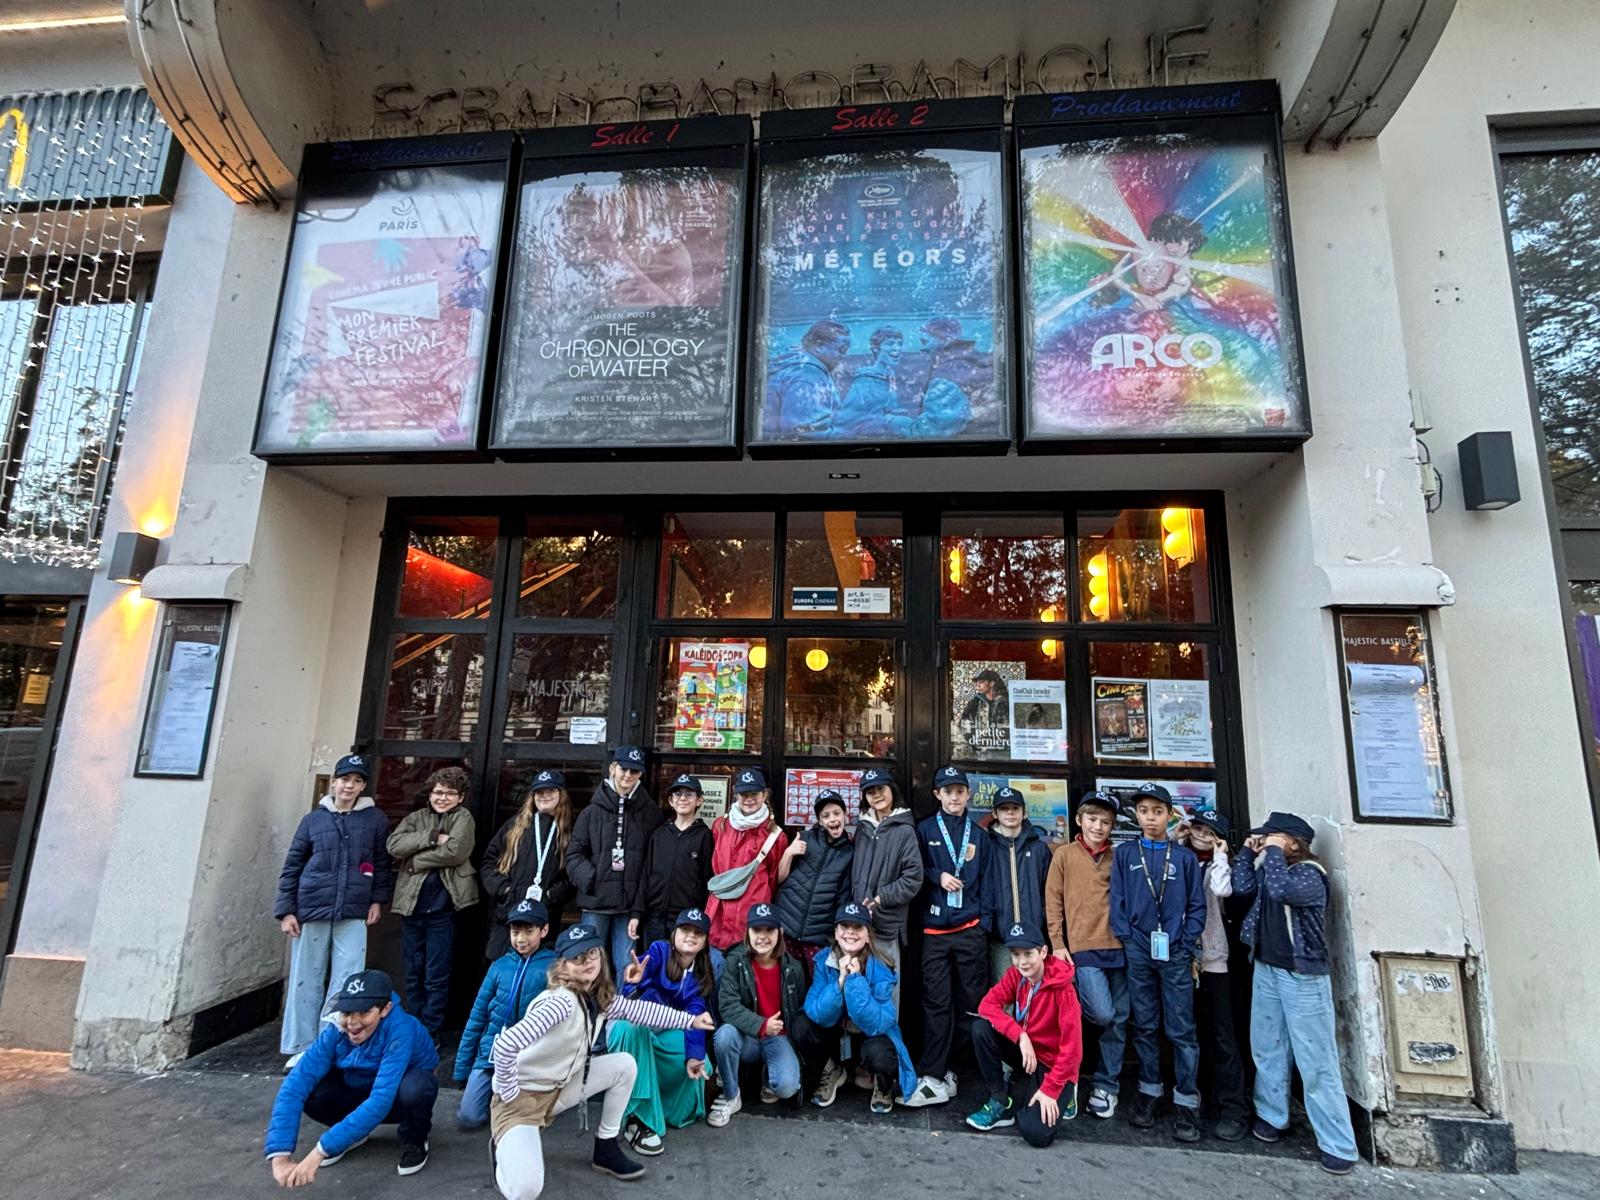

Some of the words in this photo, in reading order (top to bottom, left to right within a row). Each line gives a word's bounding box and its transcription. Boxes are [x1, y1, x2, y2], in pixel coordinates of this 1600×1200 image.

[1050, 90, 1243, 119] Prochainement
[831, 107, 899, 132] Salle
[908, 104, 930, 127] 2
[591, 124, 652, 149] Salle
[666, 123, 681, 143] 1
[379, 220, 419, 231] PARIS
[794, 247, 967, 272] MÉTÉORS
[336, 310, 376, 328] MON
[627, 311, 657, 319] POOTS
[346, 315, 423, 345] PREMIER
[606, 323, 637, 336] THE
[354, 329, 447, 367] FESTIVAL
[539, 338, 706, 359] CHRONOLOGY
[1091, 332, 1224, 371] ARCO
[568, 364, 589, 378] OF
[589, 359, 669, 378] WATER
[1343, 637, 1378, 647] MAJESTIC
[684, 647, 743, 662] KALÉIDOSCOPE
[975, 727, 1006, 740] petite
[629, 750, 642, 761] ESL
[742, 772, 755, 783] ESL
[945, 767, 959, 777] ESL
[1000, 787, 1014, 797] ESL
[517, 900, 532, 912] ESL
[756, 904, 772, 917] ESL
[845, 904, 859, 914] ESL
[688, 909, 702, 921] ESL
[569, 928, 589, 940] ESL
[1010, 924, 1025, 937] ESL
[347, 979, 365, 995] ESL
